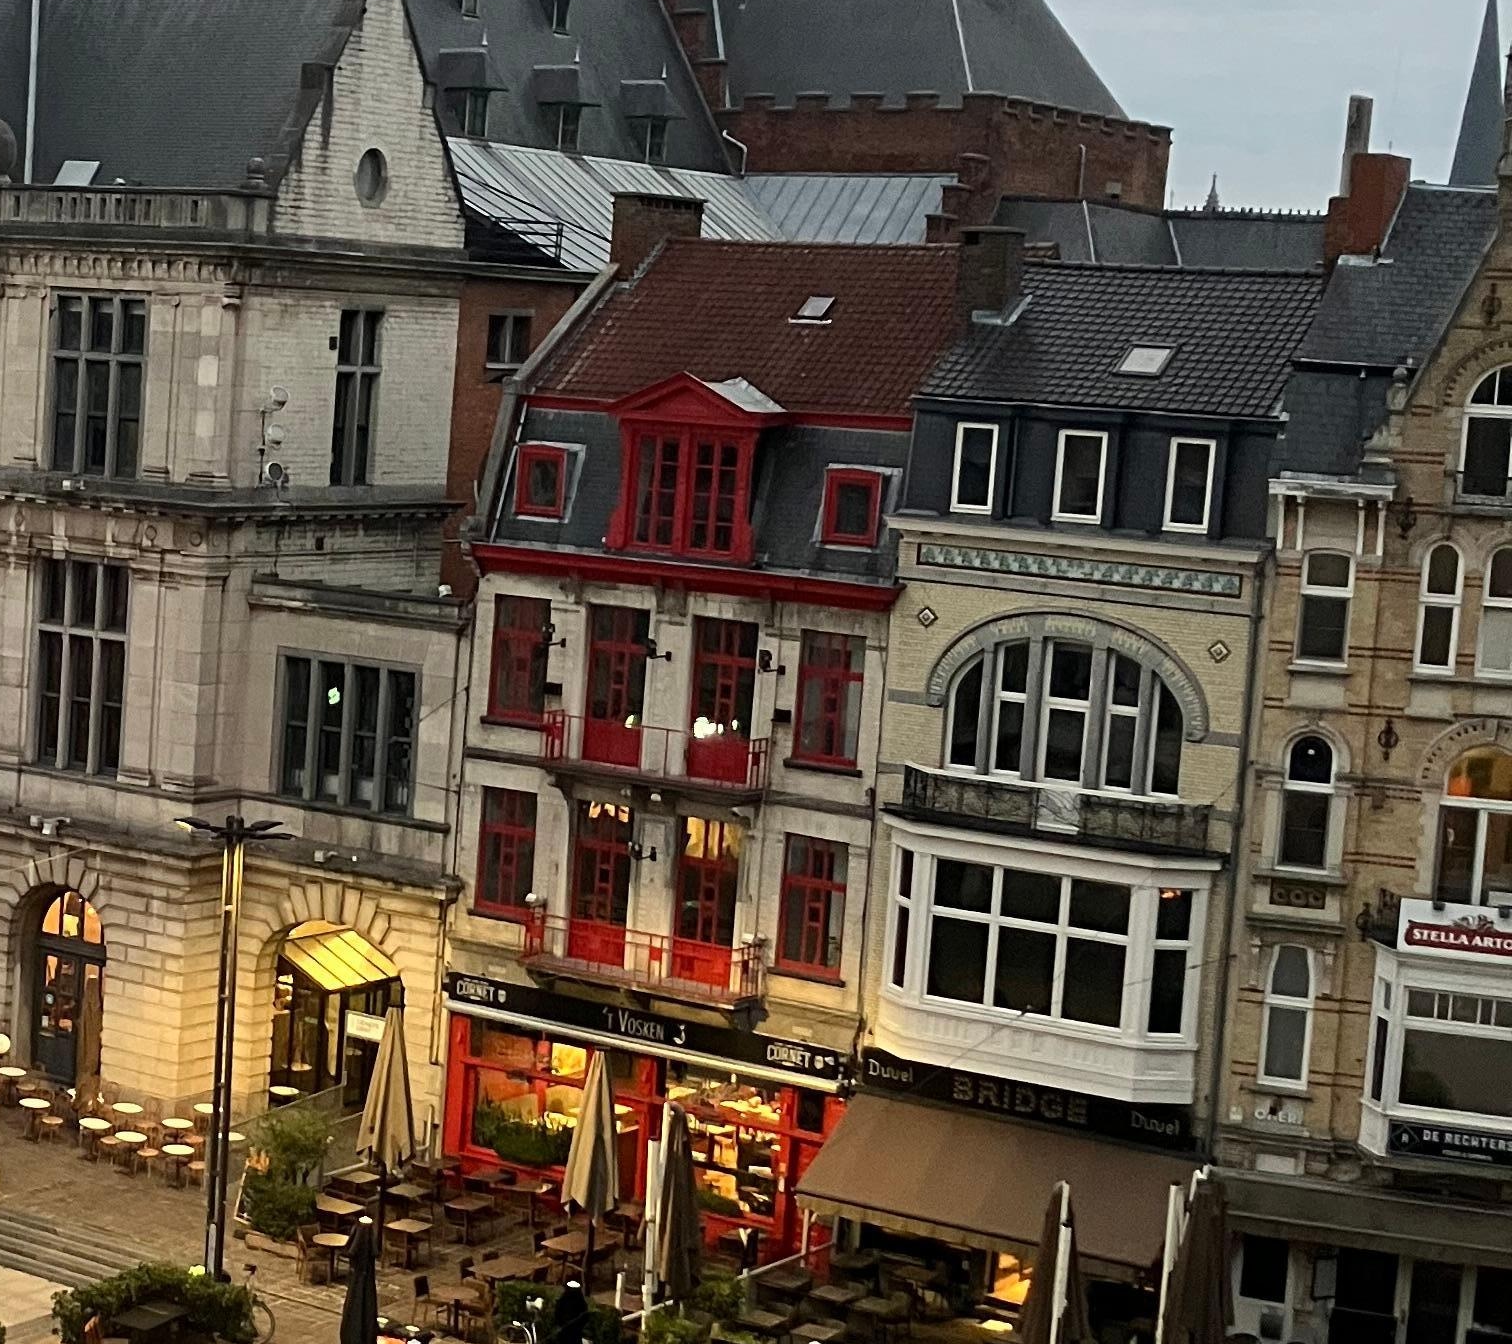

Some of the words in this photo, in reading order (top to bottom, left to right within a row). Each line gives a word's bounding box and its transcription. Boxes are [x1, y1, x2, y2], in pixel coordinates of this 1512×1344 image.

[1412, 928, 1469, 945] STELLA
[456, 979, 495, 1002] CORNET
[766, 1044, 812, 1068] CORNET
[867, 1058, 913, 1084] Duvel
[952, 1073, 1088, 1125] BRIDGE
[1130, 1110, 1180, 1136] Duvel
[1422, 1128, 1440, 1143] DE
